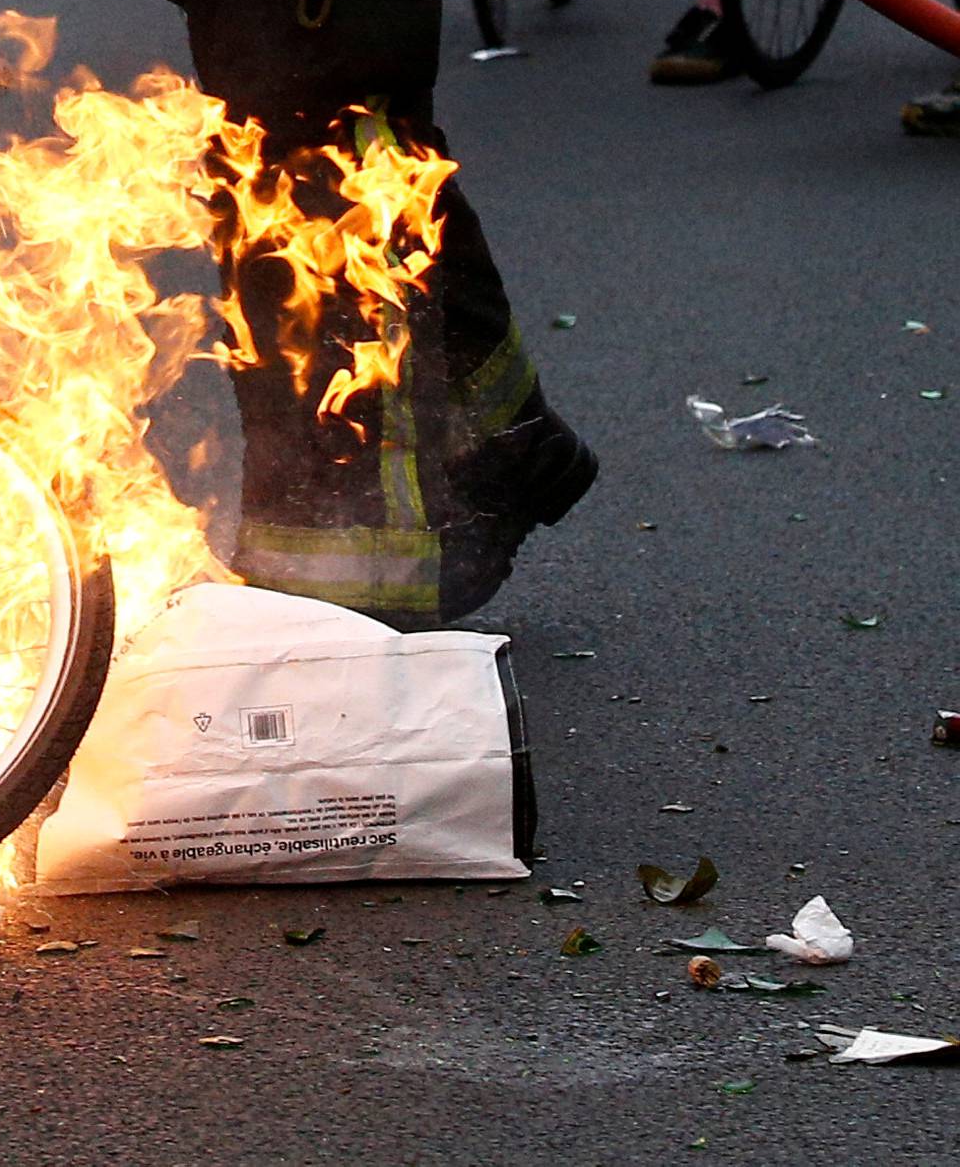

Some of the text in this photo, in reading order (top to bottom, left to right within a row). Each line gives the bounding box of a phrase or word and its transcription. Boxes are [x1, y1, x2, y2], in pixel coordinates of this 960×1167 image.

[130, 833, 397, 862] Sac réutilisable, échangeable à vie.
